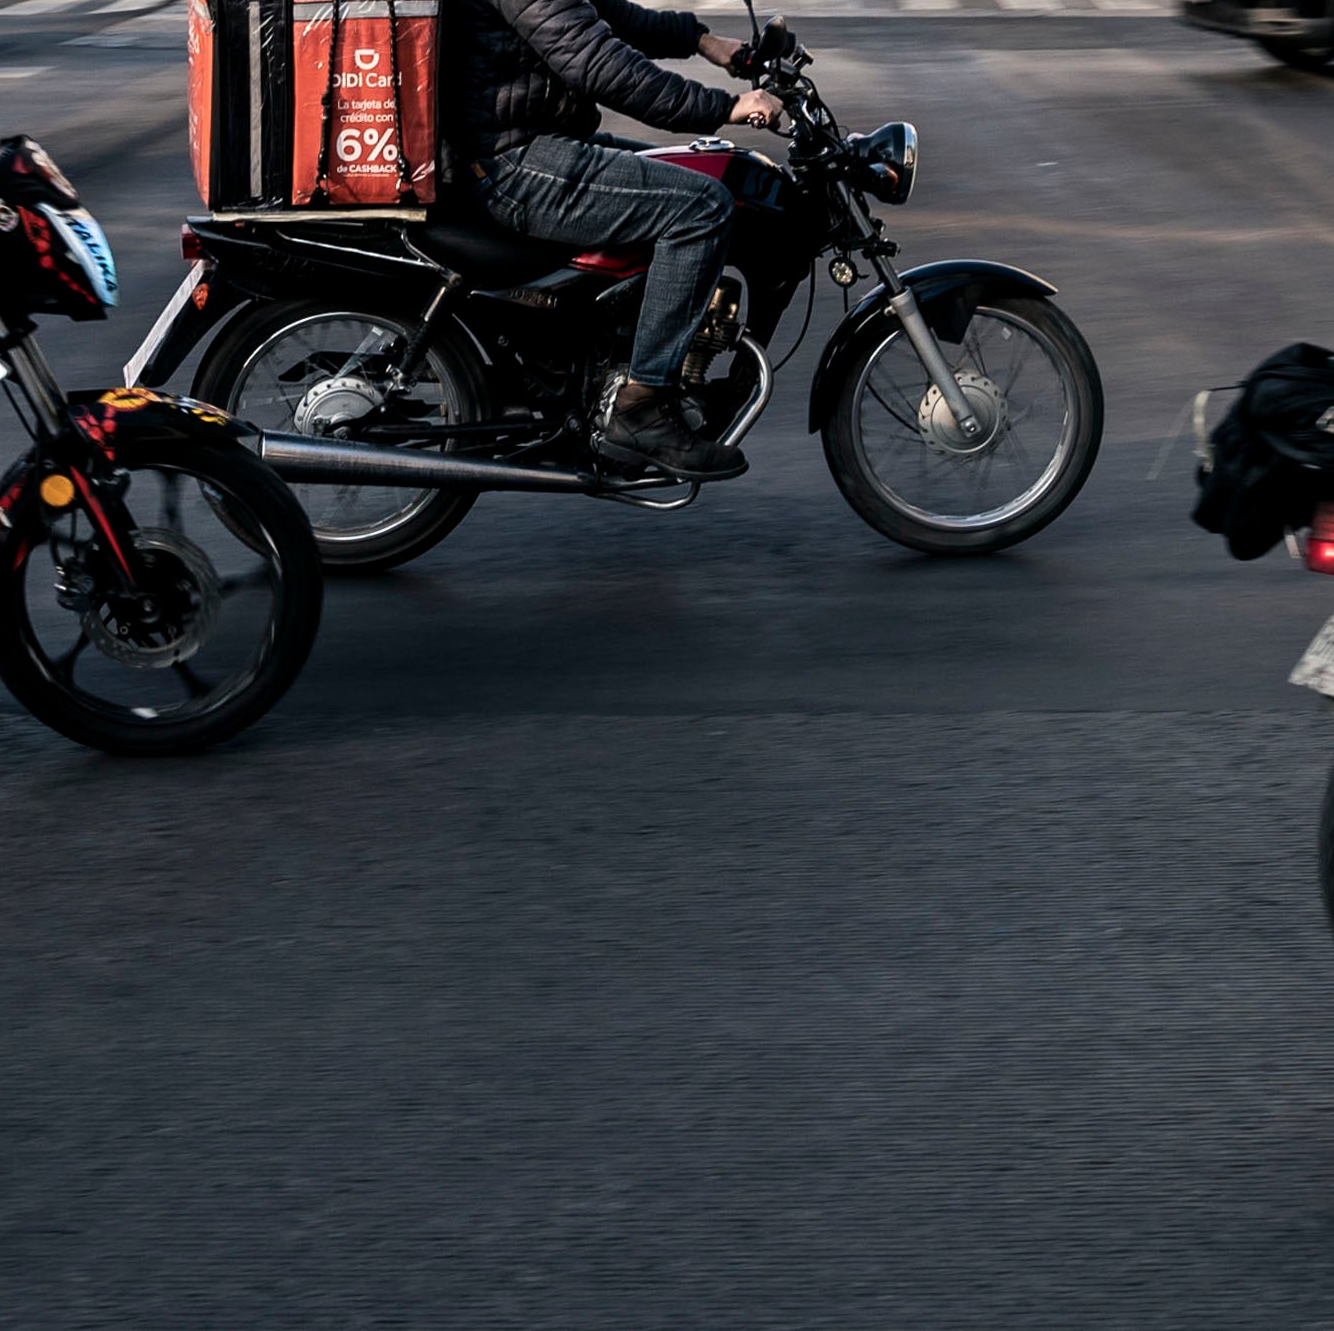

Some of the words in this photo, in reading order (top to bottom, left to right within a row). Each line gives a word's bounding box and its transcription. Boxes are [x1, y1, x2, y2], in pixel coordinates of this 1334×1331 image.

[337, 100, 349, 110] La
[351, 99, 382, 113] tarjeta
[340, 112, 374, 124] crédito
[375, 114, 394, 124] con
[336, 128, 398, 162] 6%
[336, 164, 348, 174] de
[349, 164, 397, 174] CASHBACK
